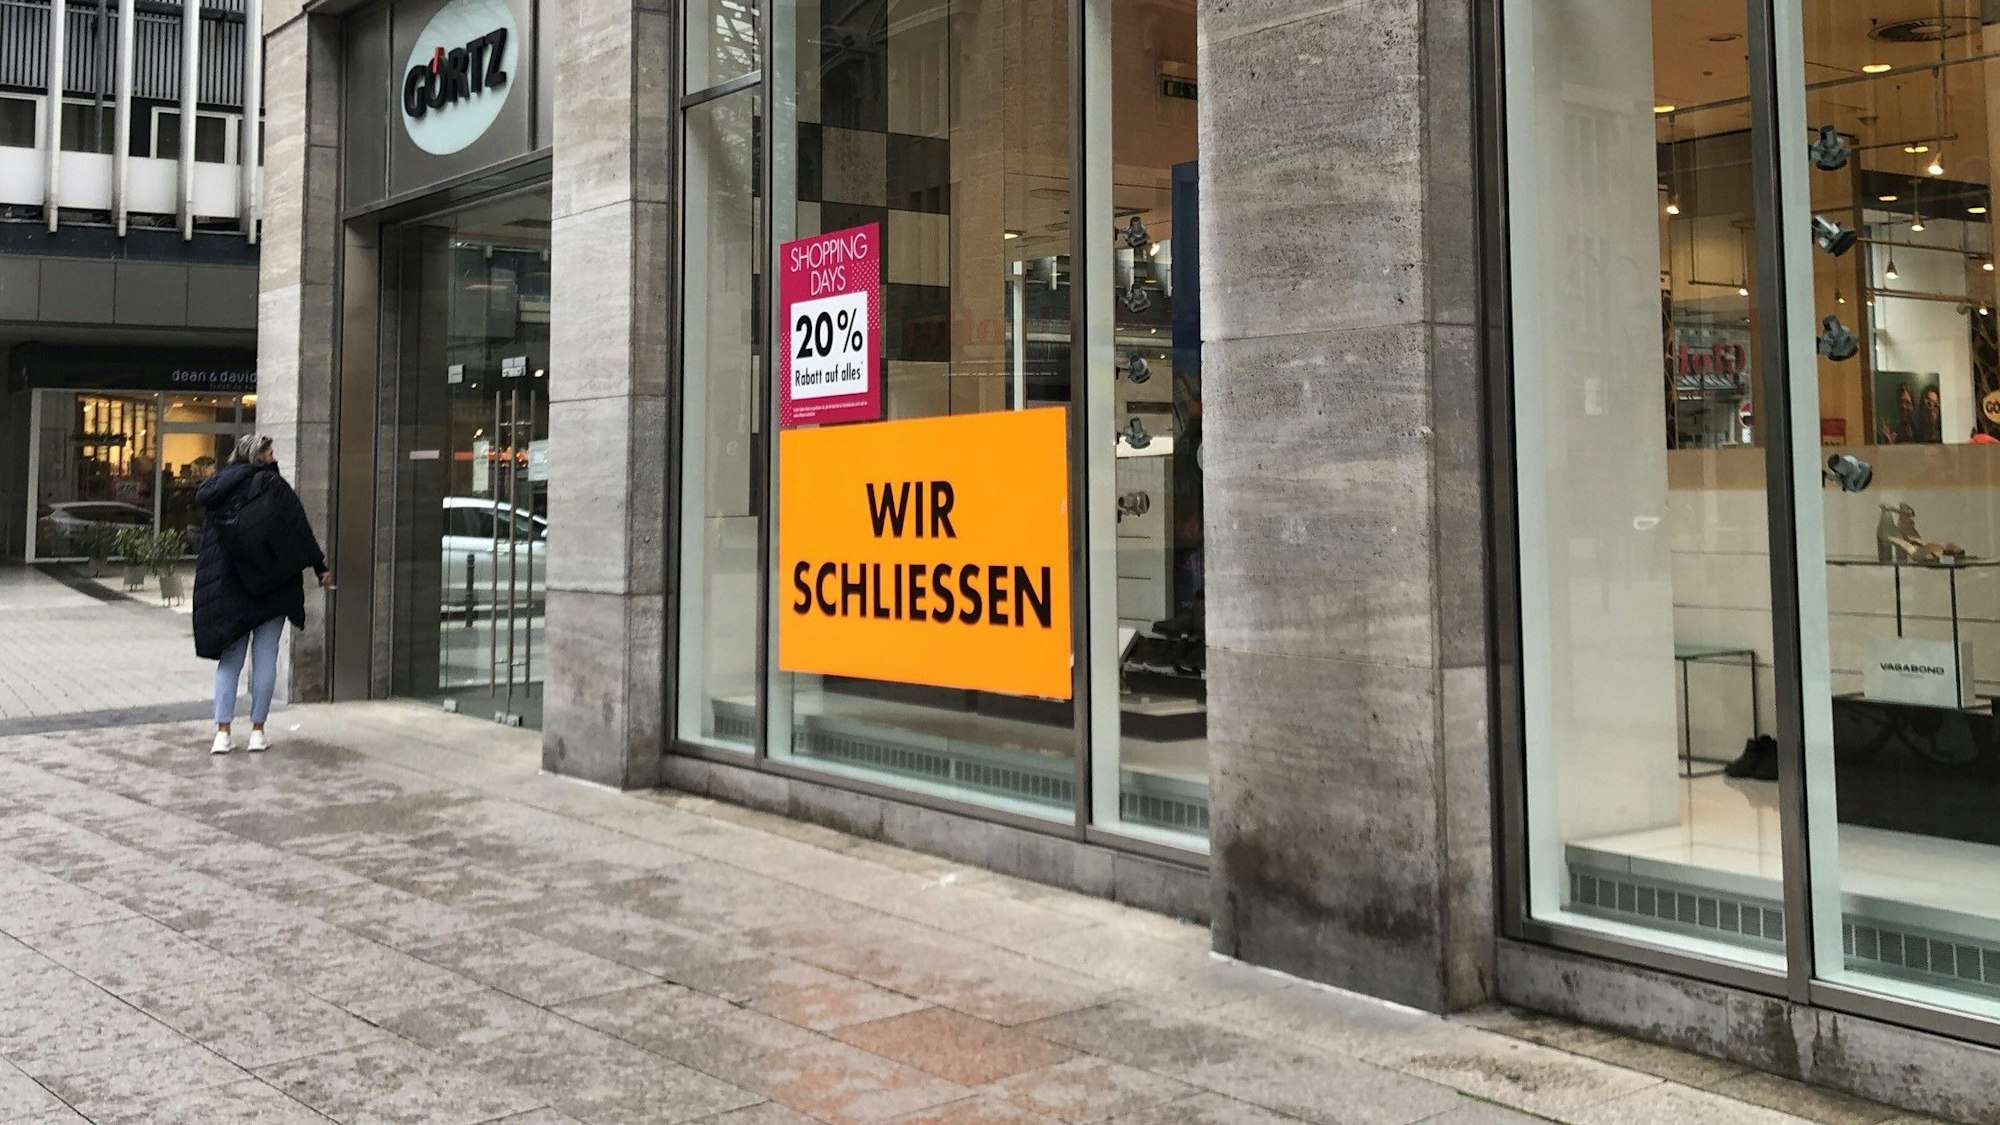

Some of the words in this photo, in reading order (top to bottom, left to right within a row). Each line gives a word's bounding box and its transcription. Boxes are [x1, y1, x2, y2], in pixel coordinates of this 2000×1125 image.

[790, 233, 868, 272] SHOPPING
[811, 265, 846, 296] DAYS
[796, 307, 863, 359] 20%
[172, 369, 207, 381] dean
[795, 367, 822, 387] Rabatt
[825, 364, 839, 384] auf
[866, 480, 957, 538] WIR
[793, 560, 1052, 629] SCHLIESSEN
[1880, 661, 1945, 676] VAGABOND
